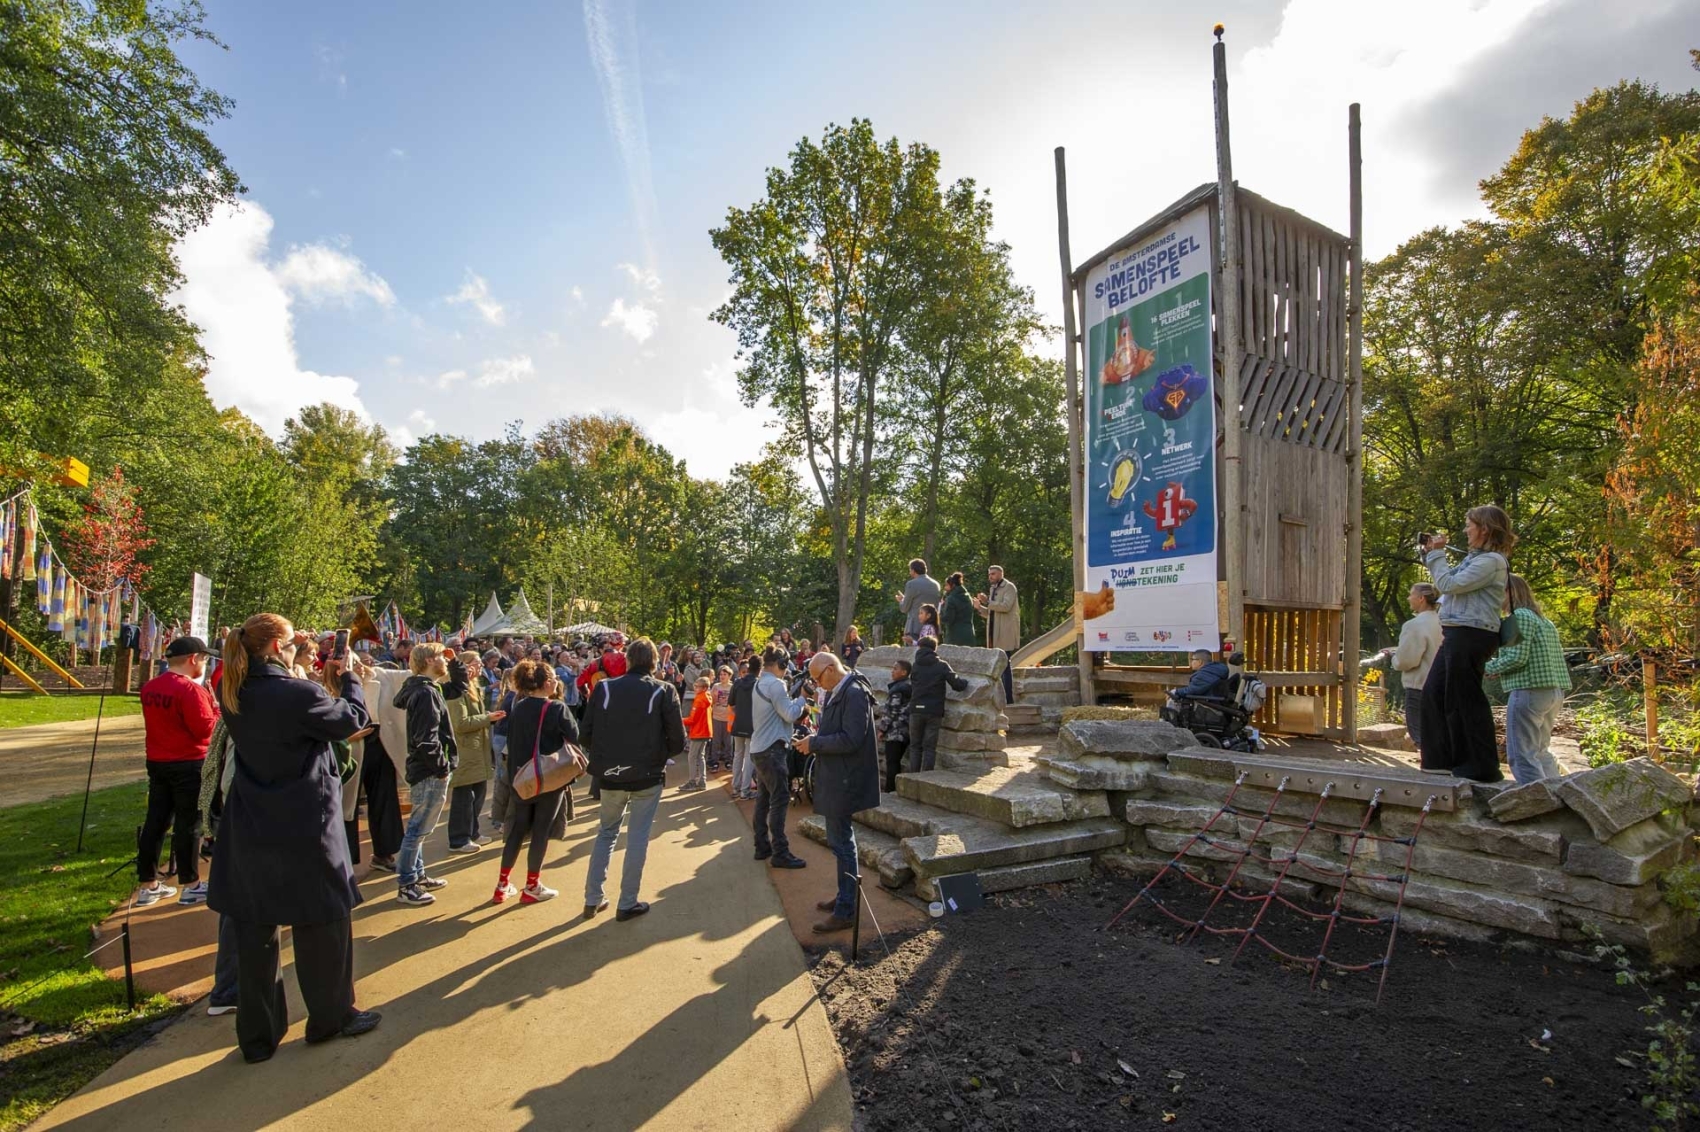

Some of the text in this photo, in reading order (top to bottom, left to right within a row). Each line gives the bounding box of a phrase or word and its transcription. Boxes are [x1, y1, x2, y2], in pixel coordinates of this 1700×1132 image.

[1109, 232, 1176, 271] DE AMSTERDAMSE
[1095, 235, 1200, 299] SAMENSPEEL
[1108, 260, 1181, 309] BELOFTE
[1158, 299, 1202, 321] SAMENSPEEL
[1160, 310, 1190, 327] PLEKKEN
[1163, 428, 1175, 448] 3
[1161, 441, 1192, 455] NETWERK
[1123, 510, 1136, 528] 4
[1110, 526, 1143, 538] INSPIRATIE
[1110, 563, 1185, 580] DUIM ZET HIER JE
